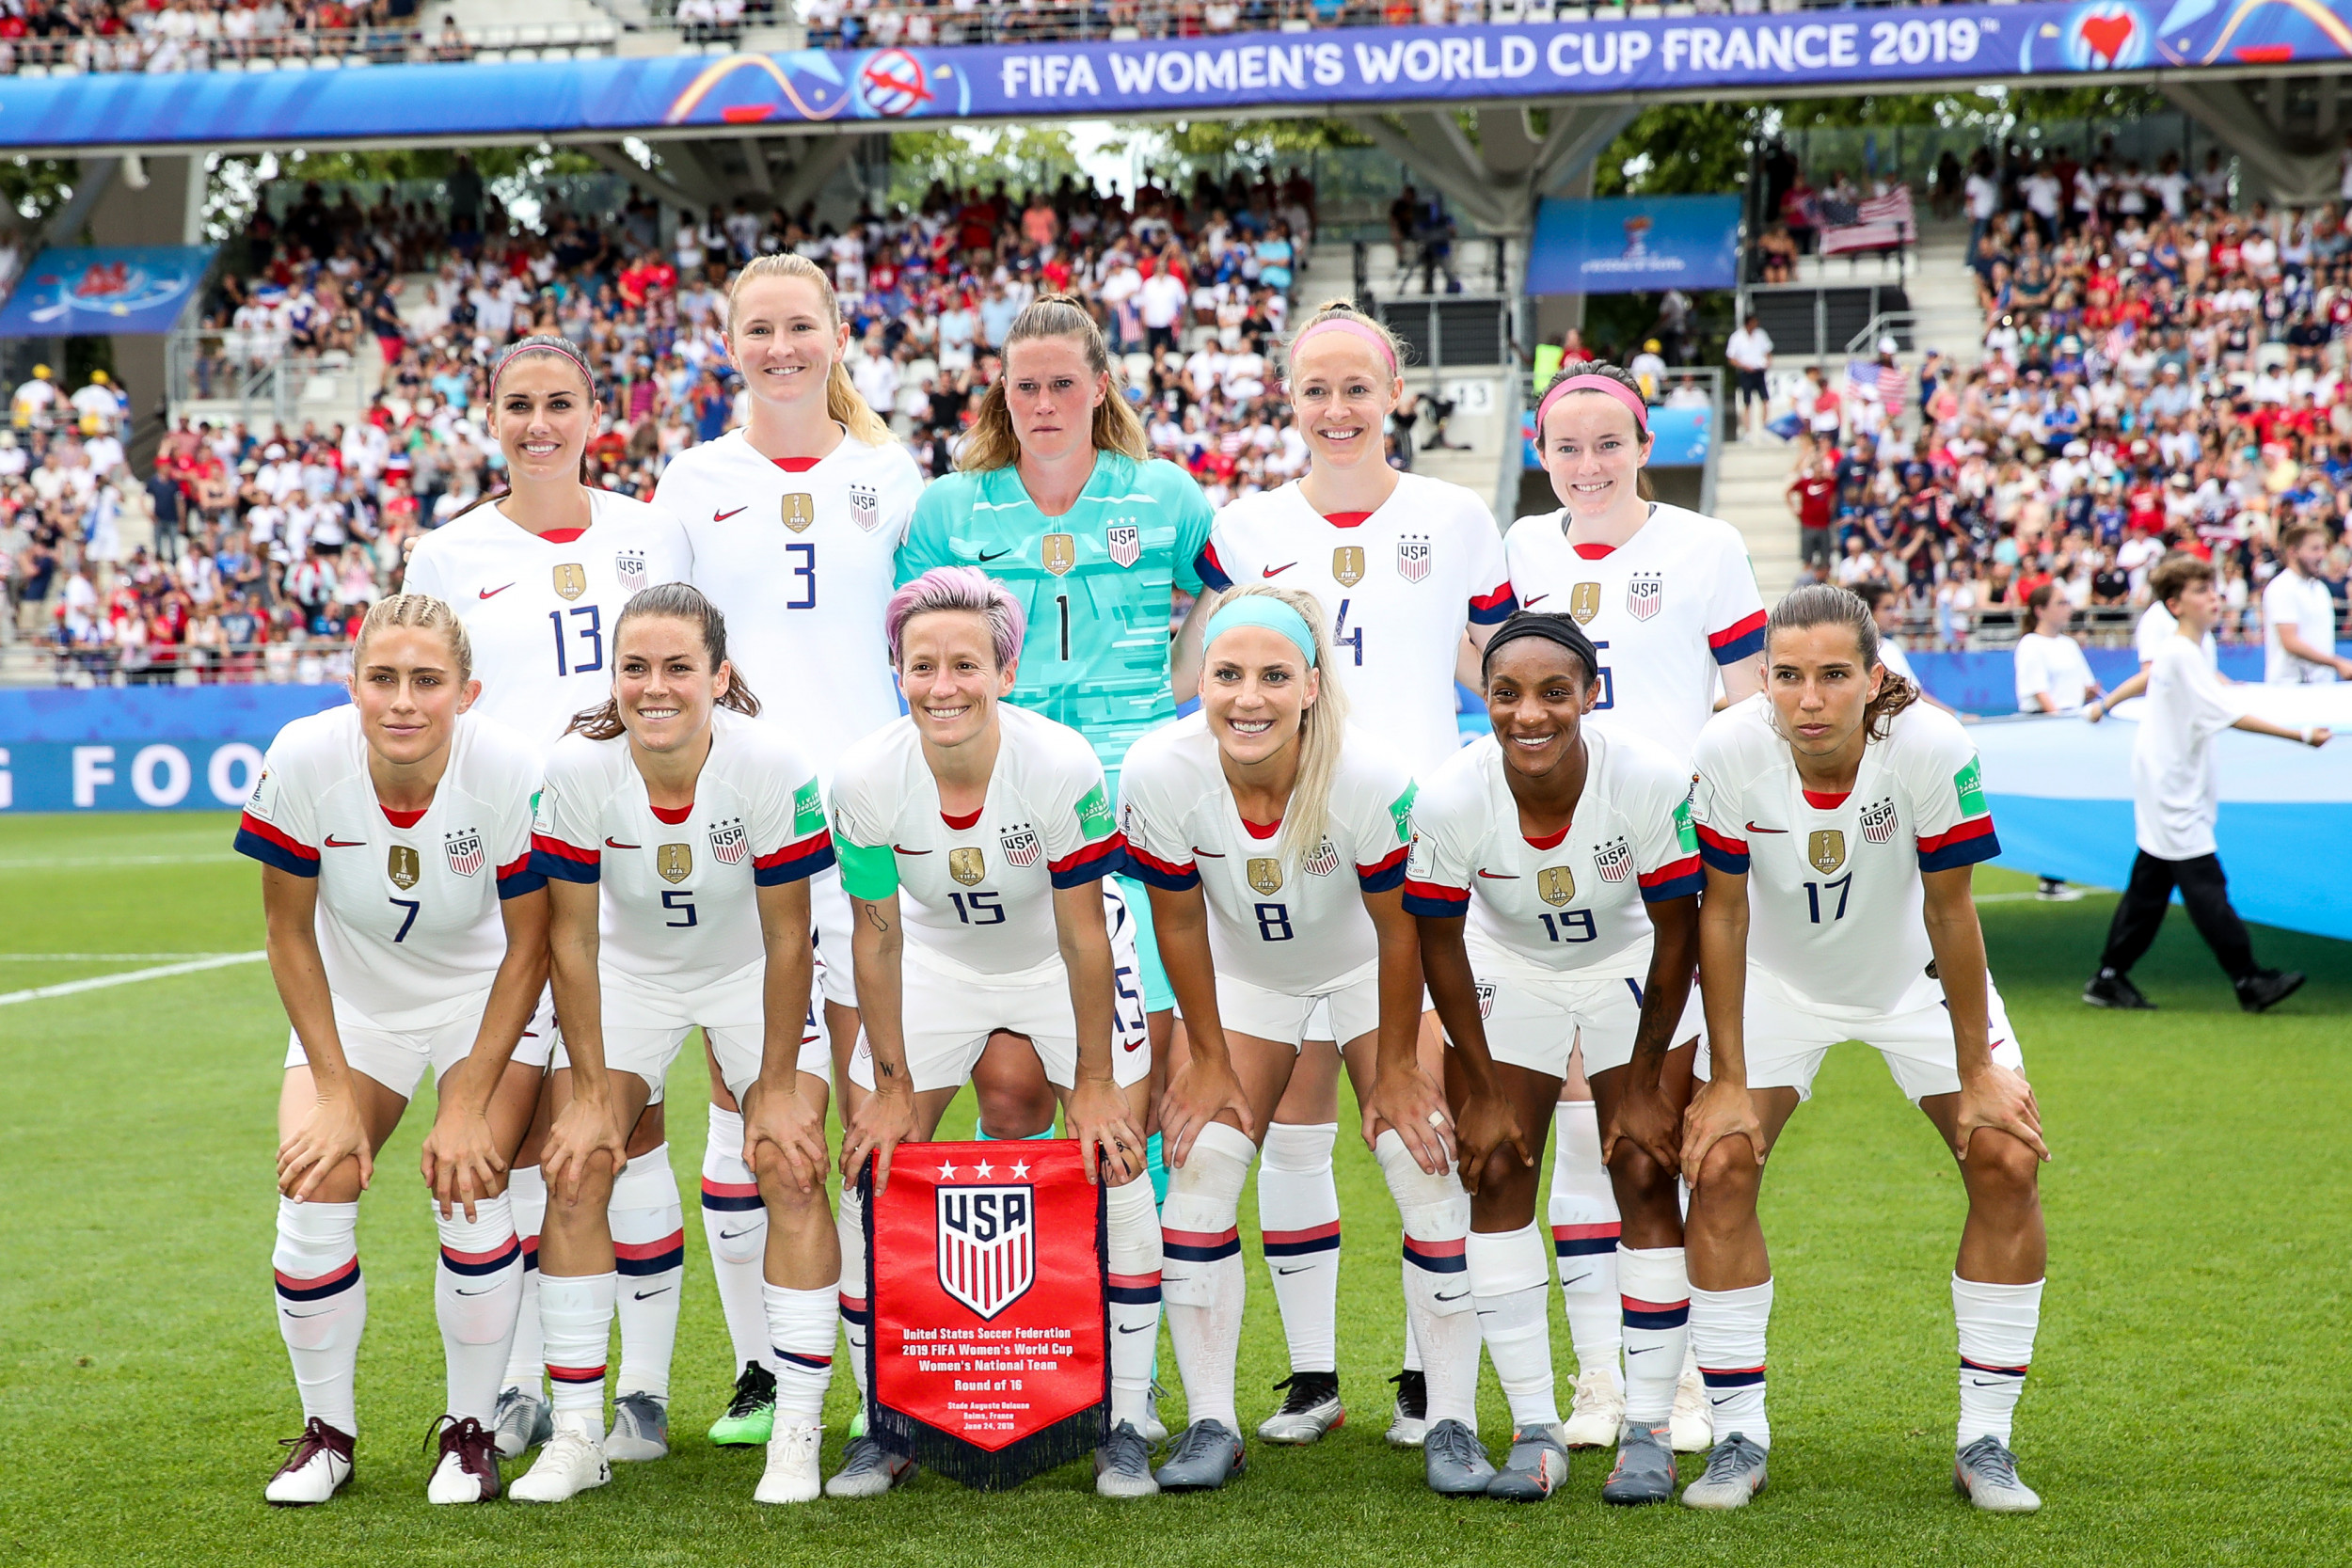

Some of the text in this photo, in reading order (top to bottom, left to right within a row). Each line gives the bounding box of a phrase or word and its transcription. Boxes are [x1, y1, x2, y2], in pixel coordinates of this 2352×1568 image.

[1002, 55, 1100, 98] FIFA
[1108, 42, 1345, 95] WOMEN'S
[1355, 35, 1538, 85] WORLD
[1546, 30, 1652, 78] CUP
[1662, 23, 1861, 72] FRANCE
[852, 494, 875, 510] USA
[1110, 529, 1136, 545] USA
[1401, 546, 1427, 561] USA
[619, 560, 644, 575] USA
[785, 543, 816, 610] 3
[1631, 583, 1659, 597] USA
[1056, 594, 1070, 661] 1
[1332, 598, 1362, 667] 4
[549, 605, 603, 677] 13
[1864, 806, 1892, 826] USA
[713, 828, 742, 846] USA
[1005, 833, 1034, 849] USA
[449, 839, 478, 856] USA
[1305, 845, 1331, 860] SA
[1598, 847, 1627, 865] USA
[1802, 871, 1853, 924] 17
[660, 890, 698, 927] 5
[947, 891, 1007, 925] 15
[389, 896, 421, 943] 7
[1253, 903, 1295, 942] 8
[1537, 909, 1597, 943] 19
[1475, 987, 1493, 1002] SA
[945, 1194, 1025, 1243] USA
[903, 1327, 1071, 1339] United States Soccer Federation
[902, 1343, 1073, 1356] 2019 FIFA Women's World Cup
[918, 1359, 1057, 1371] Women's National Team
[954, 1379, 1023, 1391] Round of 16
[947, 1402, 968, 1410] Stade
[970, 1402, 1000, 1411] Auguste
